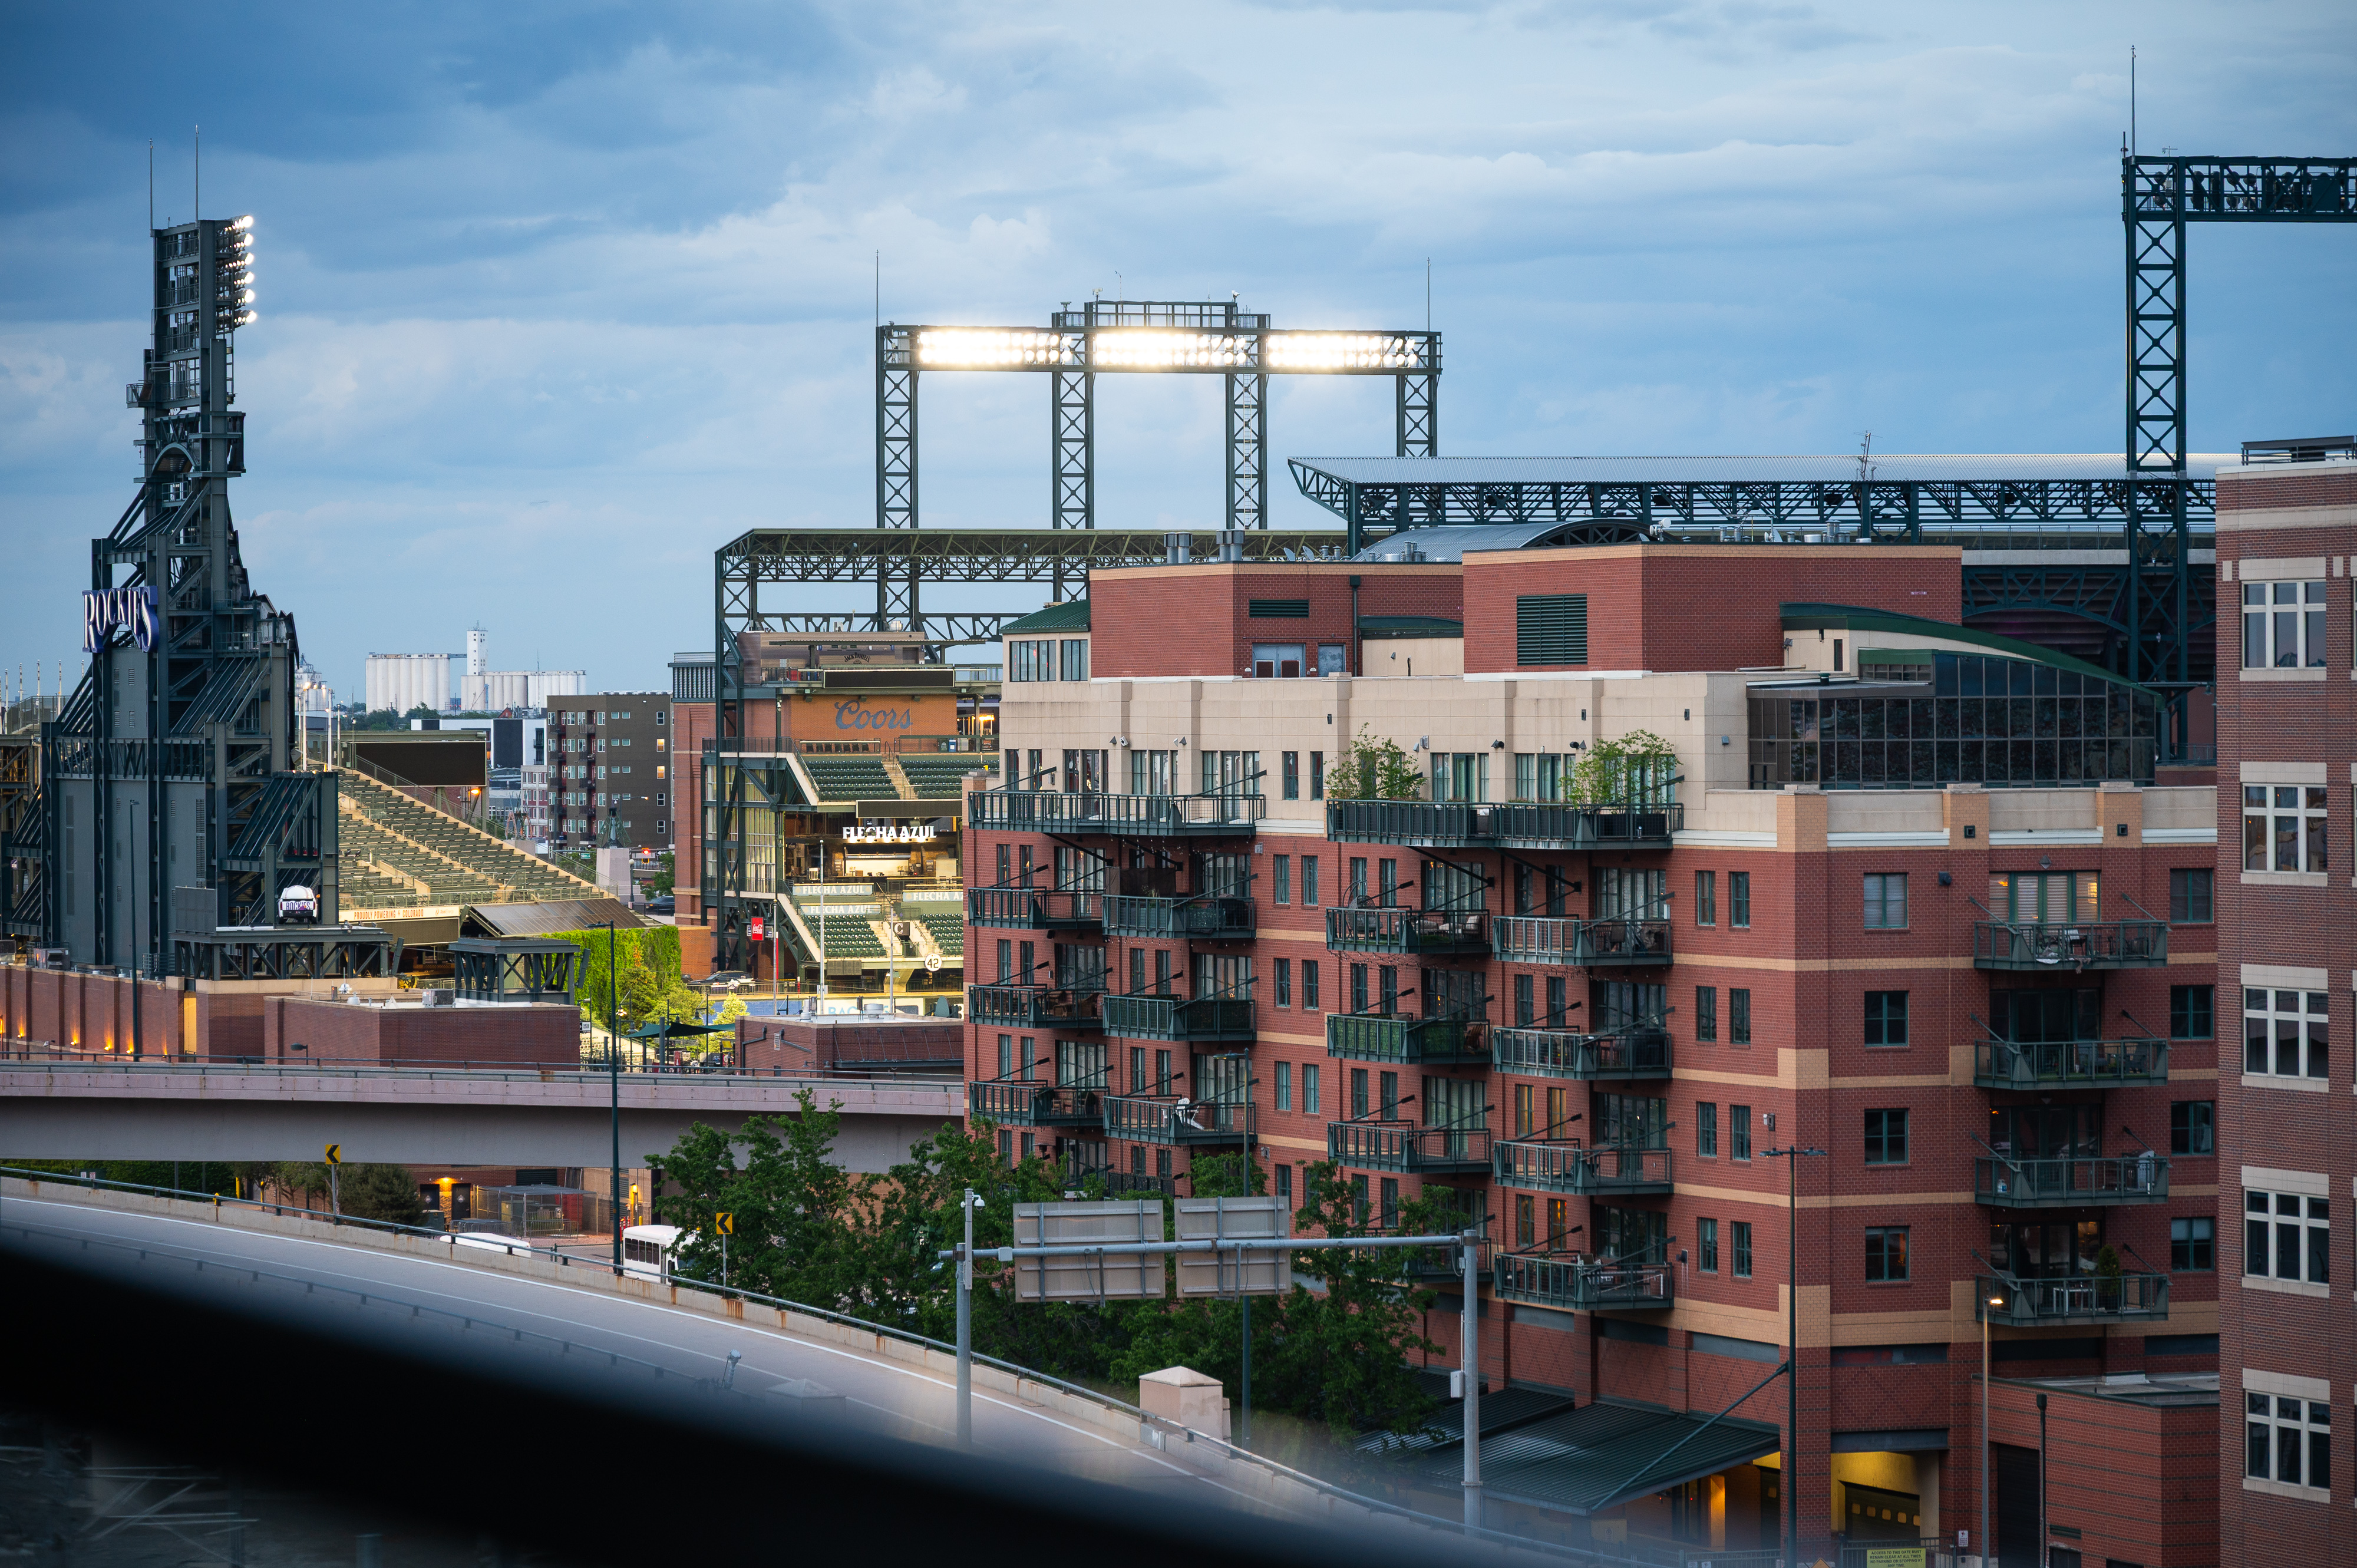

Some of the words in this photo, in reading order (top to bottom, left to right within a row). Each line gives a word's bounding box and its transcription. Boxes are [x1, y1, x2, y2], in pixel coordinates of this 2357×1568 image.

[82, 586, 158, 653] ROCKIES
[844, 653, 854, 662] JACK
[834, 699, 911, 729] Coors
[842, 826, 897, 839] FLECHA
[899, 826, 937, 839] AZUL
[803, 886, 837, 894] FLECHA
[840, 885, 864, 893] AZUL
[913, 892, 950, 900] FLECHA
[354, 911, 372, 919] PROUDLY
[374, 910, 395, 919] POWERING
[402, 909, 423, 917] COLORADO
[810, 905, 845, 914] FLECHA
[847, 905, 872, 913] AZUL
[894, 923, 903, 935] C
[927, 958, 939, 968] 42
